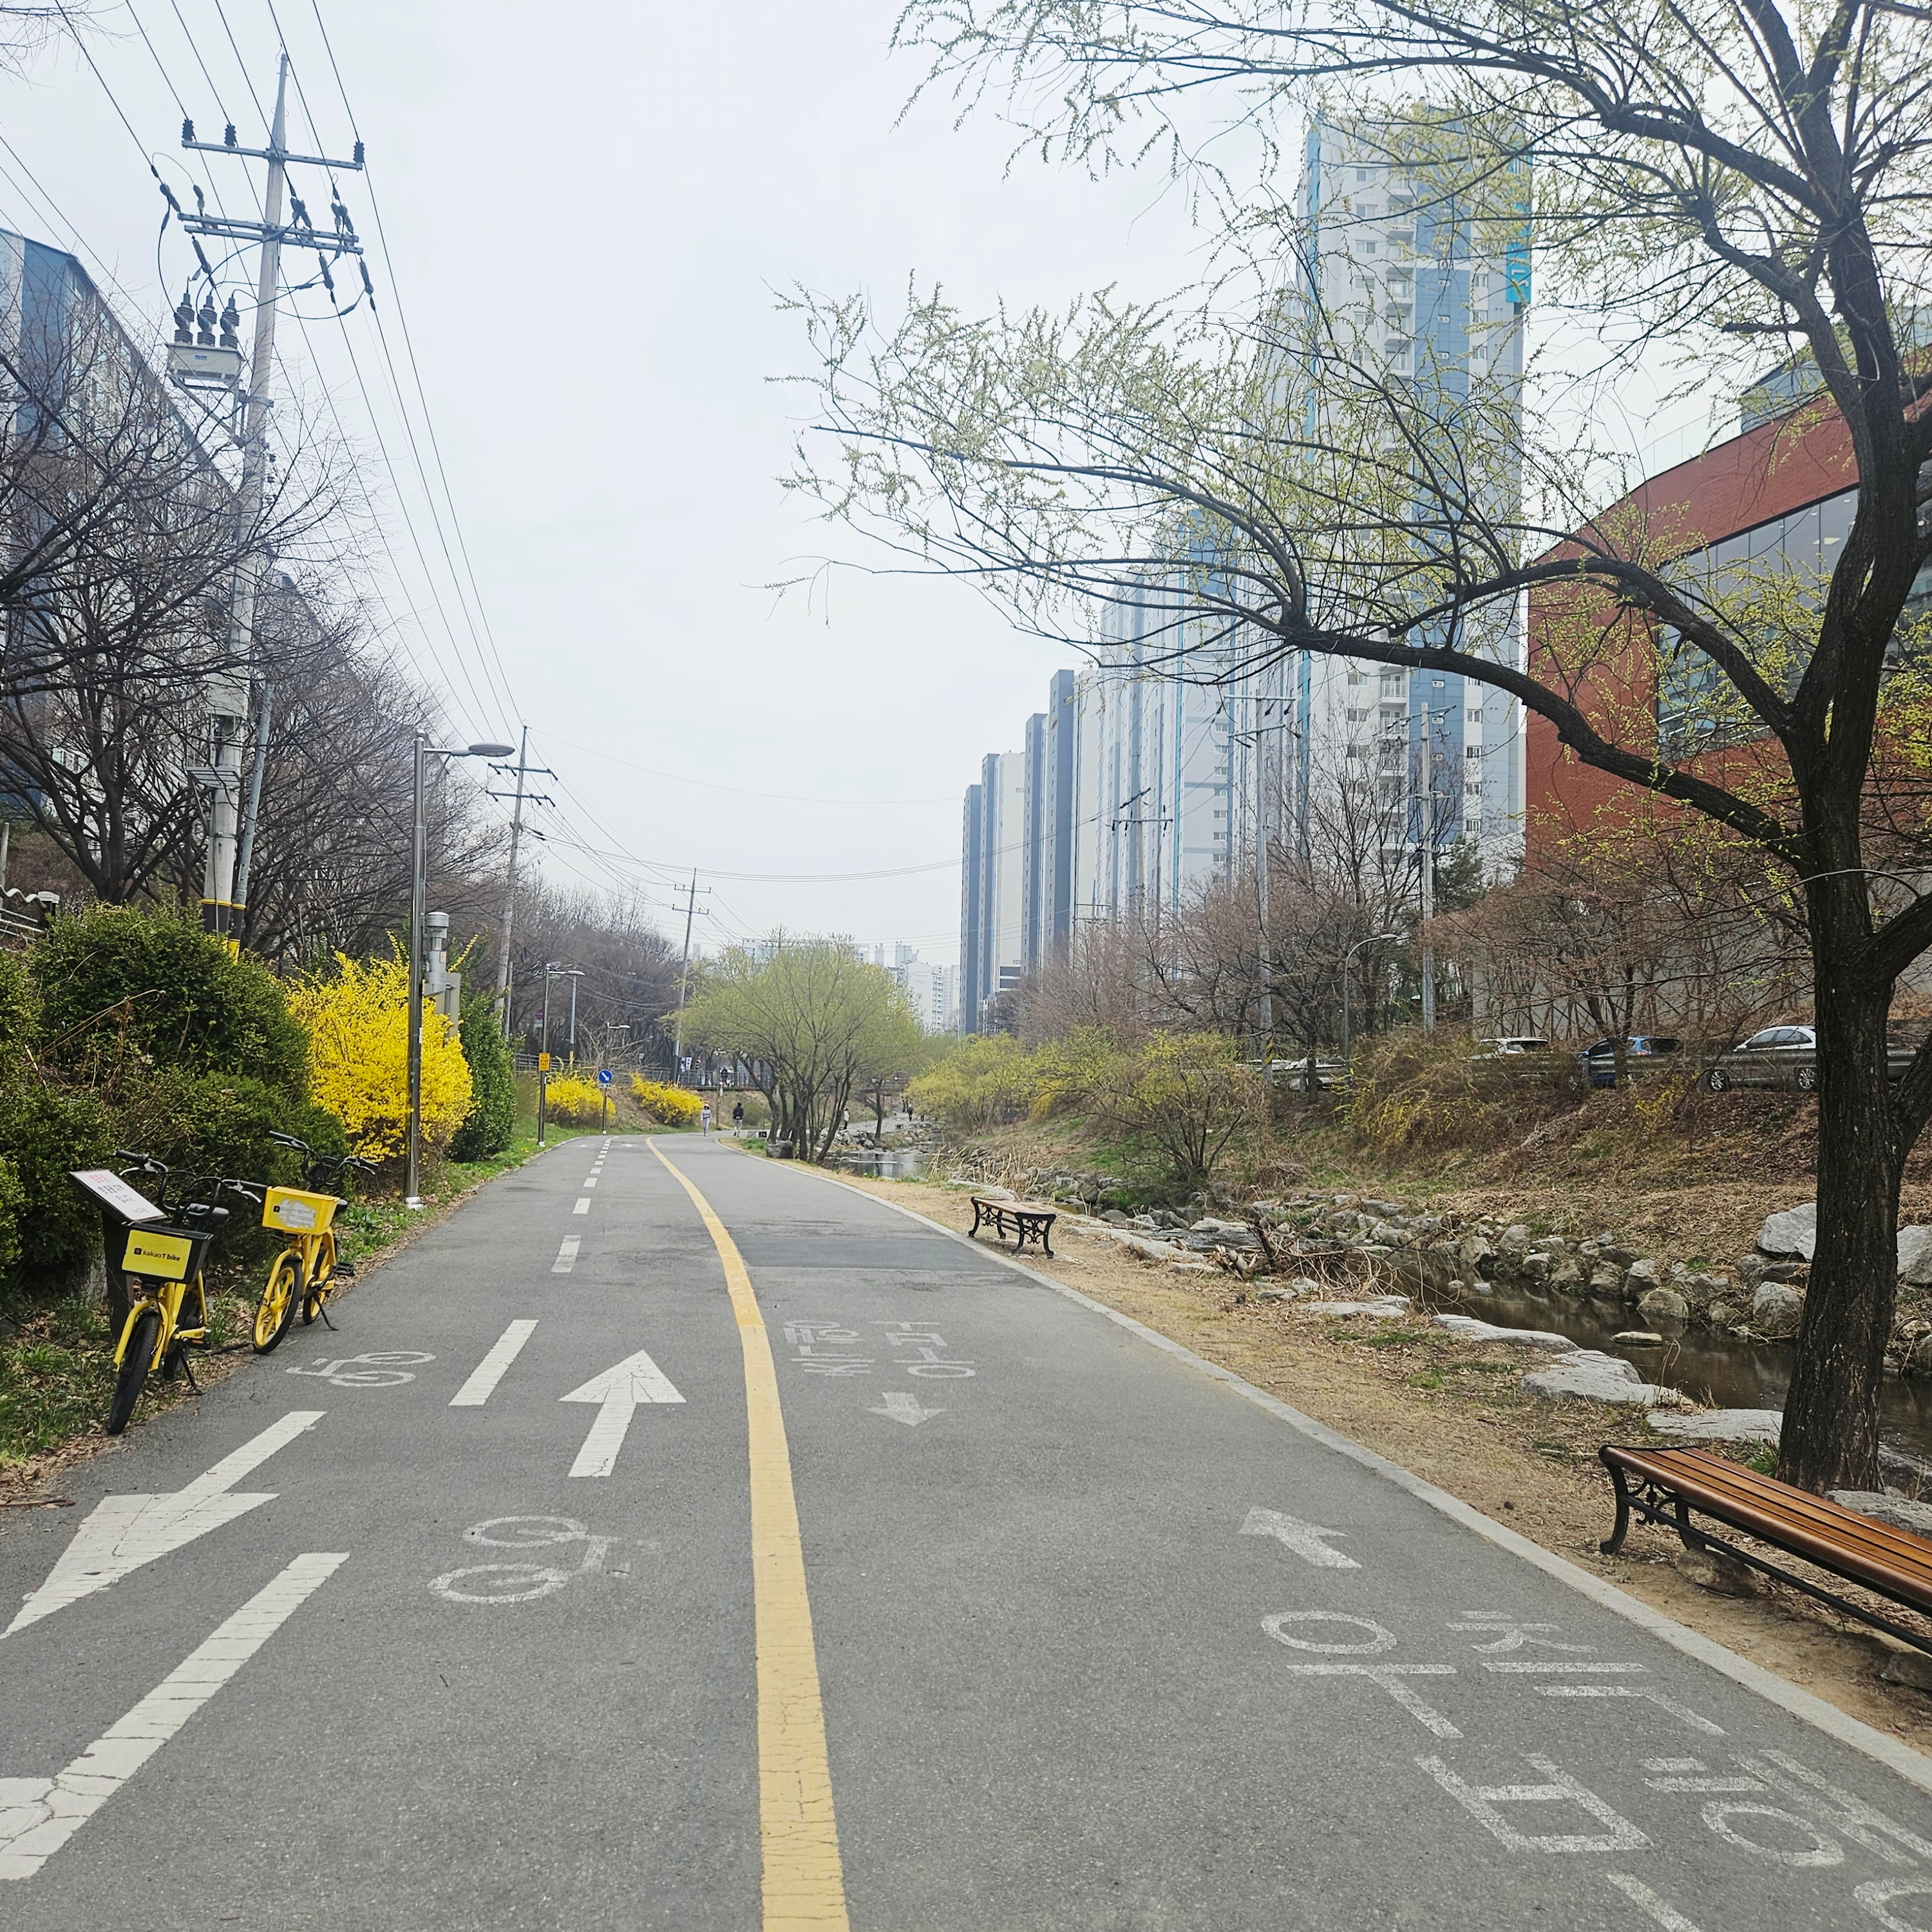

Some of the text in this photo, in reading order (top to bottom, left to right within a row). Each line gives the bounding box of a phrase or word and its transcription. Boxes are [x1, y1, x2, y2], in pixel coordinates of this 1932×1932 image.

[142, 1249, 161, 1258] kakao
[784, 1320, 949, 1347] 보행
[791, 1345, 976, 1379] 우측
[1260, 1610, 1728, 1739] 우측
